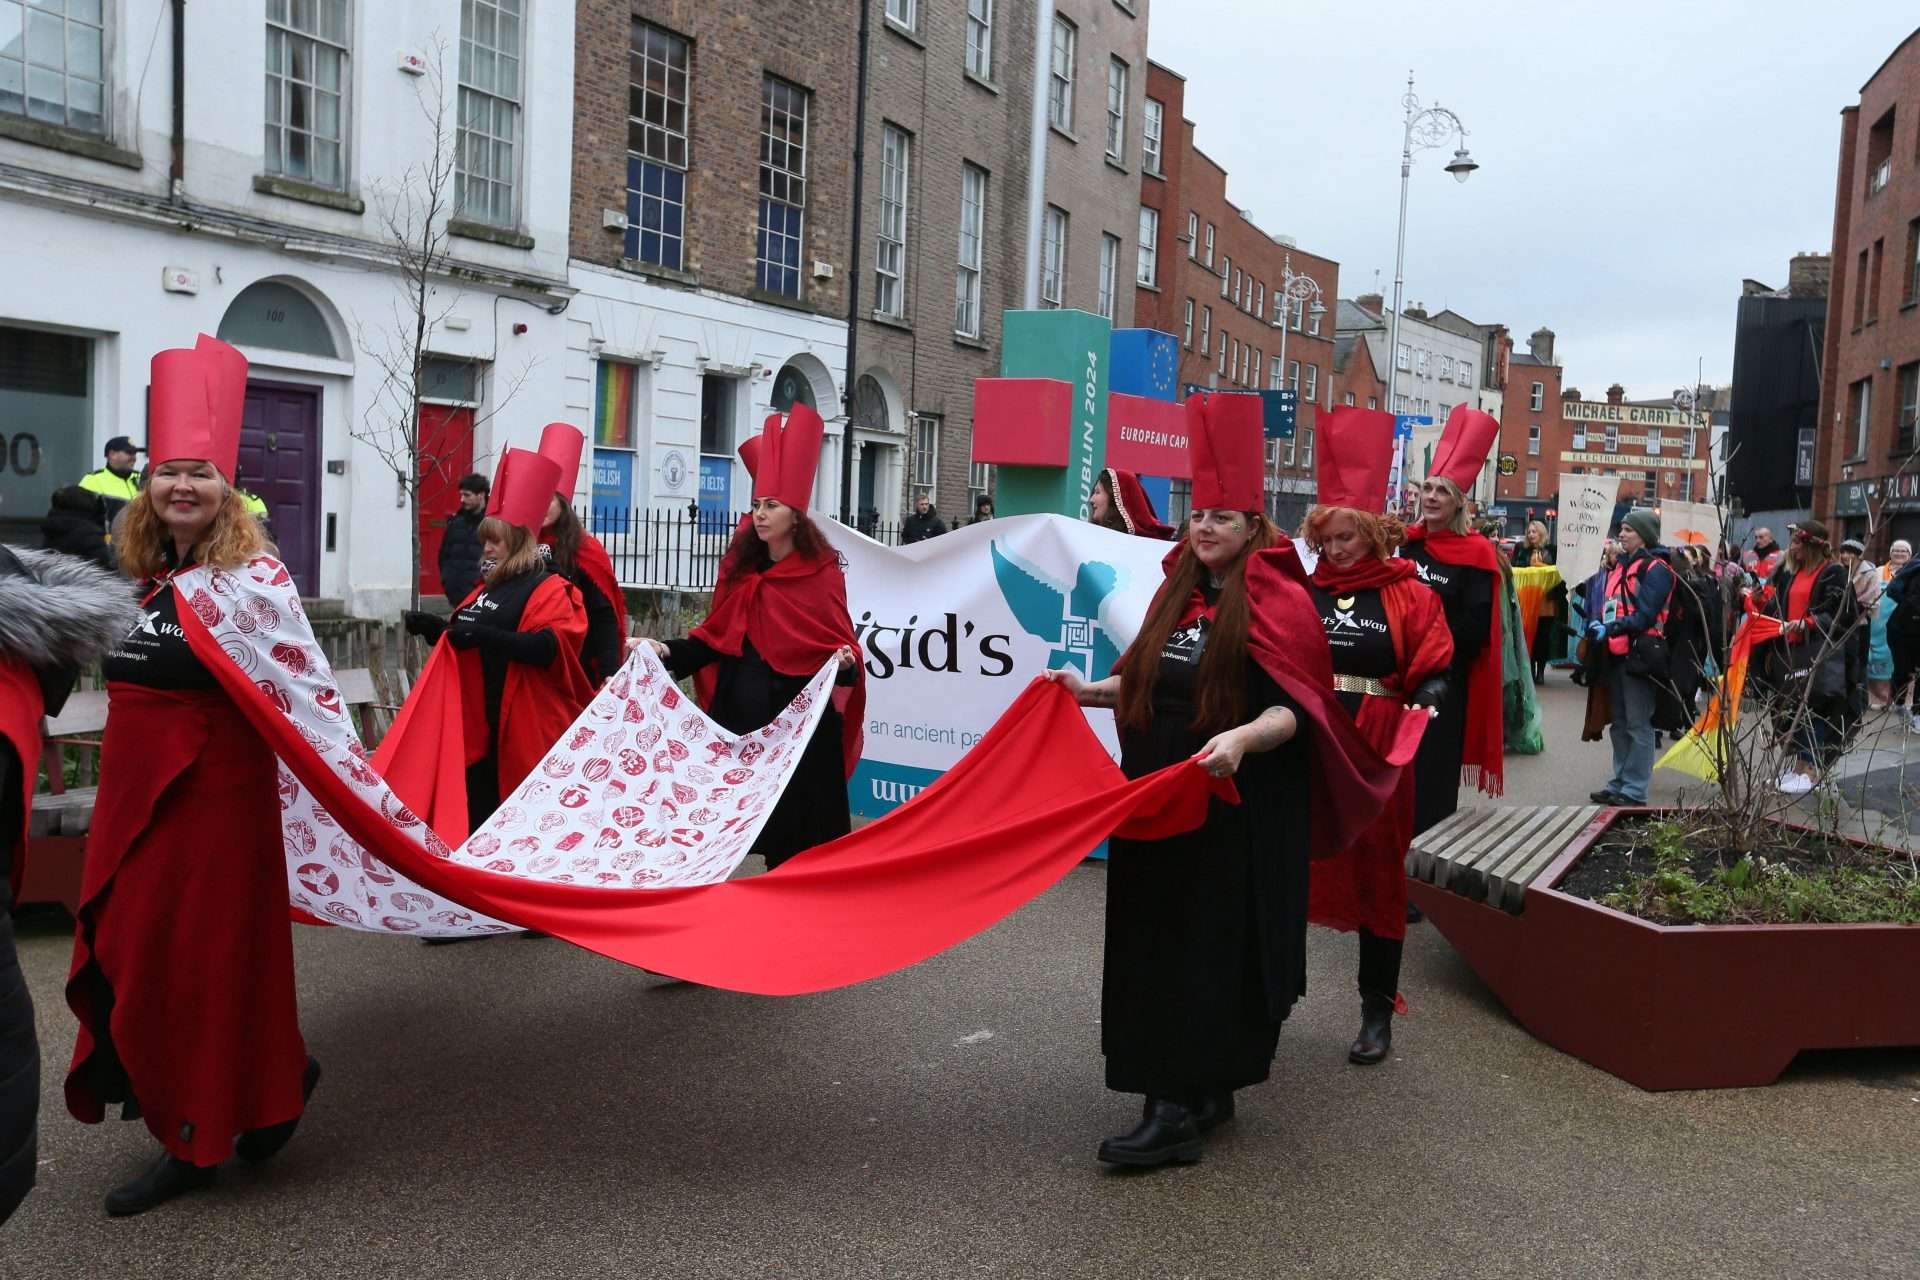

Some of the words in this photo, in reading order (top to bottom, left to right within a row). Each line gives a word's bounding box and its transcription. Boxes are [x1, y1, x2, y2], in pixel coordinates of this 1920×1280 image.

[265, 309, 285, 323] 100
[1085, 350, 1097, 416] 2024
[1565, 403, 1624, 420] MICHAEL
[1630, 408, 1671, 424] GARRY
[1120, 426, 1168, 447] EUROPEAN
[1169, 434, 1189, 449] CAPI
[592, 469, 621, 487] NGLISH
[1079, 420, 1094, 522] DUBLIN
[706, 475, 725, 492] IELTS
[854, 611, 1014, 679] igid's
[870, 720, 889, 736] an
[894, 723, 956, 745] ancient
[961, 731, 984, 750] pa
